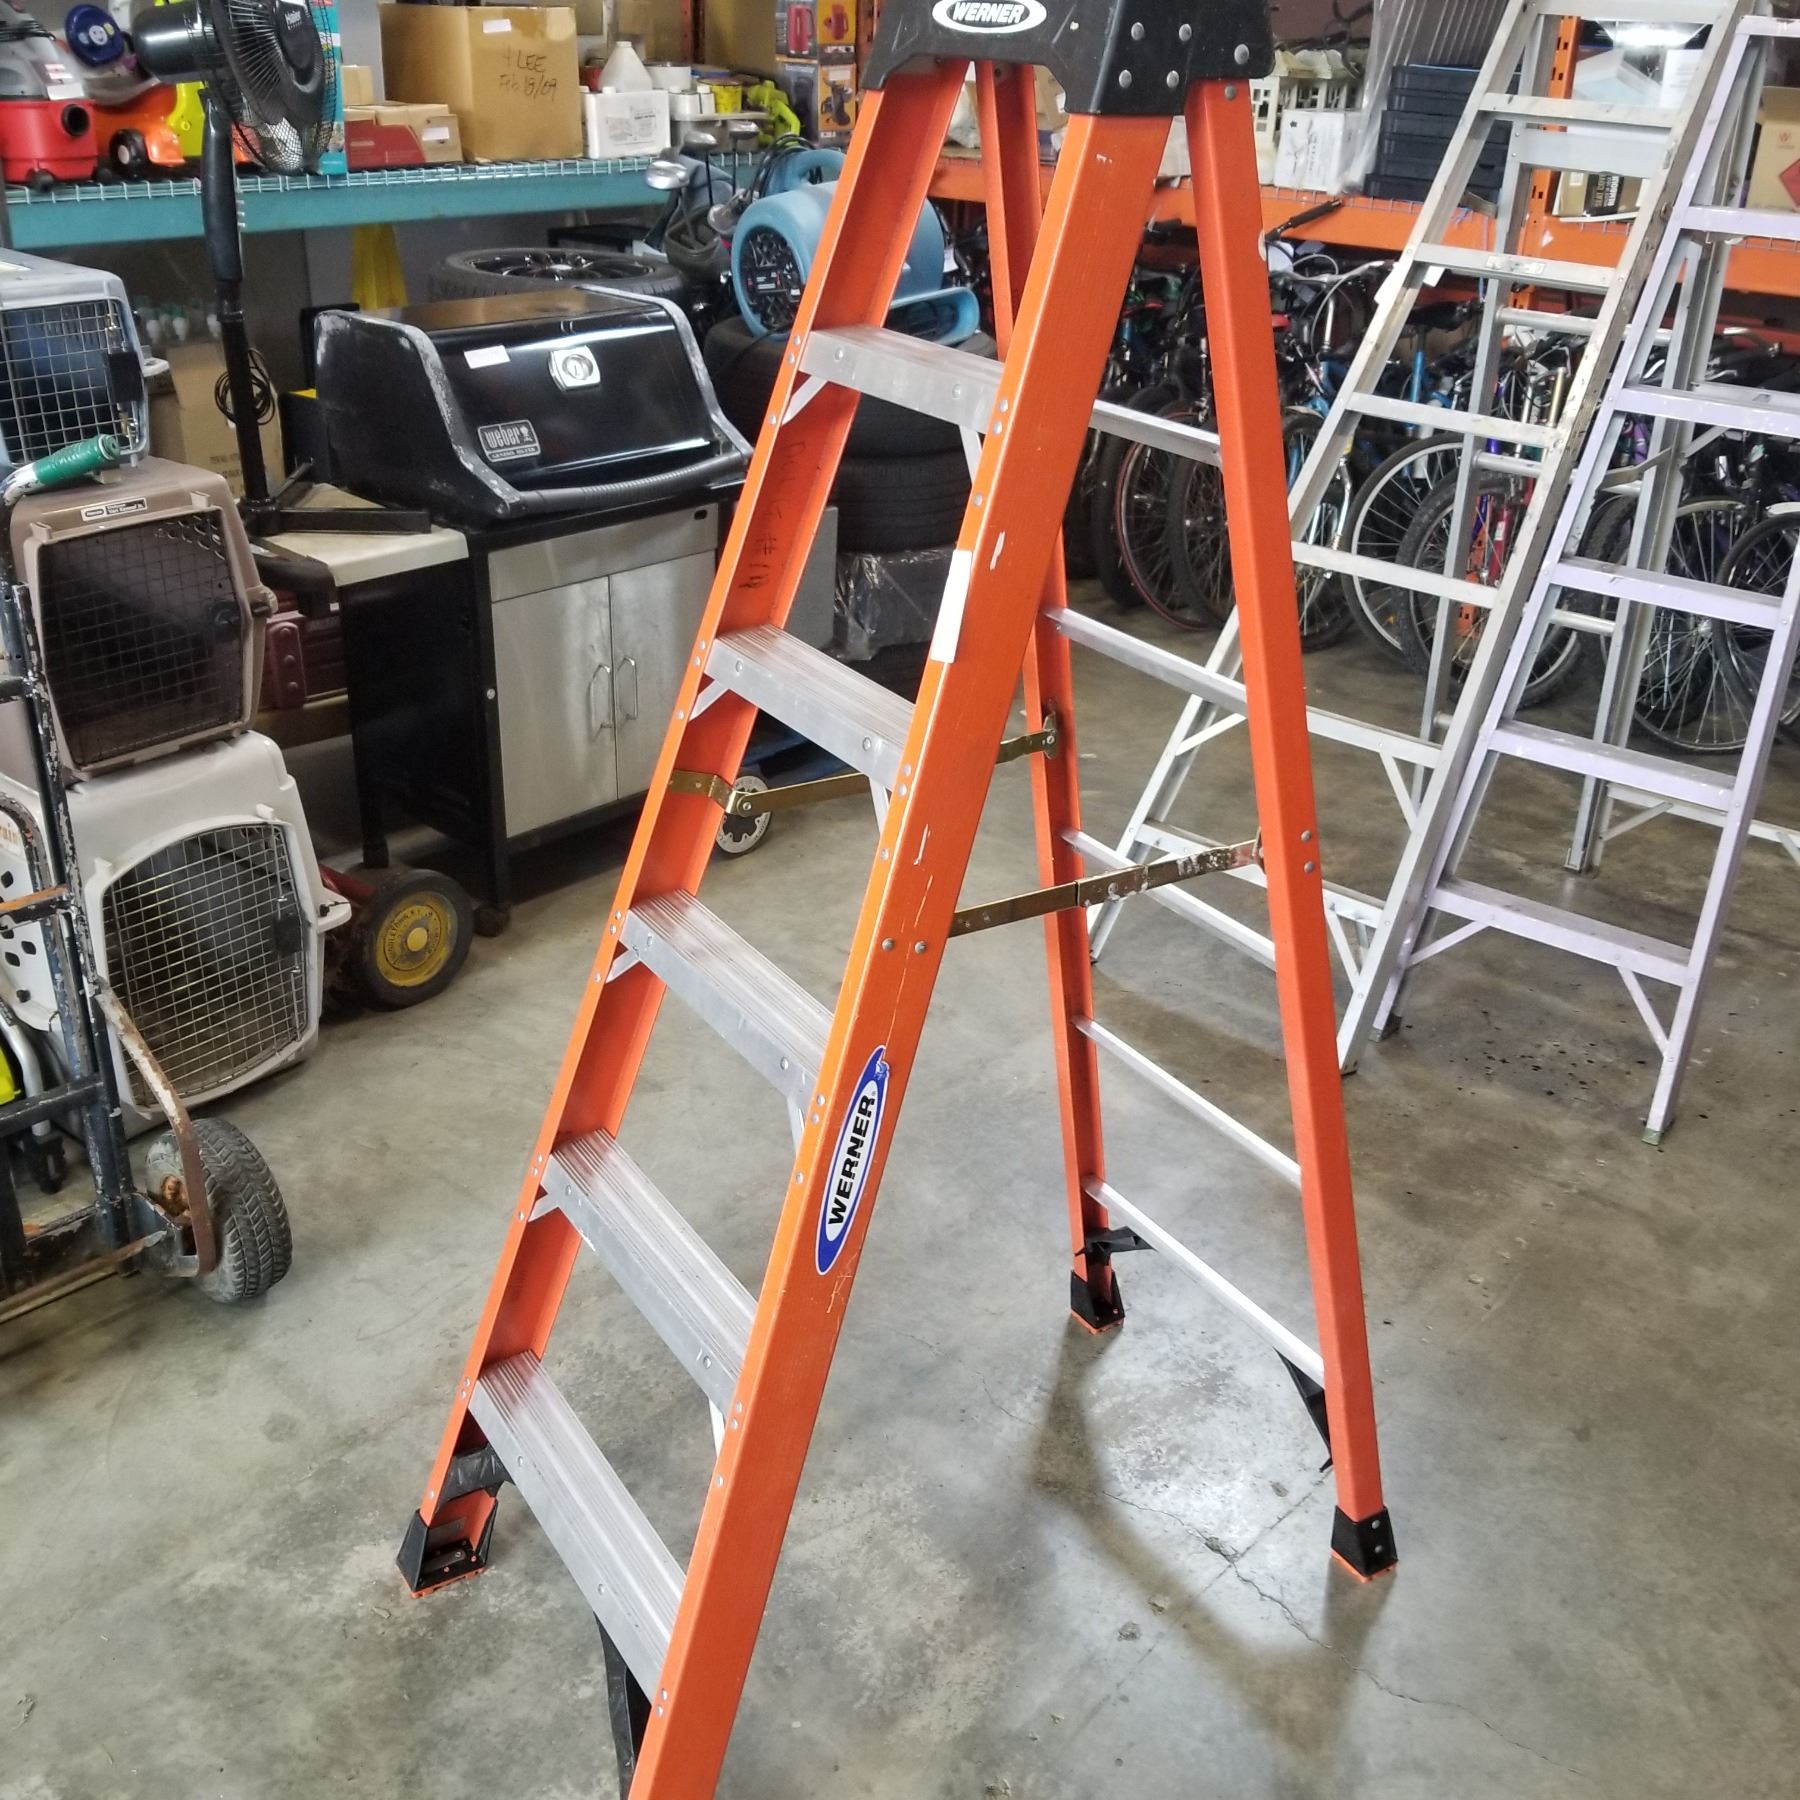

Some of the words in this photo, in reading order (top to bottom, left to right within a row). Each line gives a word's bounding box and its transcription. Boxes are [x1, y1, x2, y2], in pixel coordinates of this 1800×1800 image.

[953, 1, 1025, 24] WERNER
[517, 49, 547, 73] LEE
[484, 424, 521, 449] weber
[828, 1094, 876, 1225] WERNER
